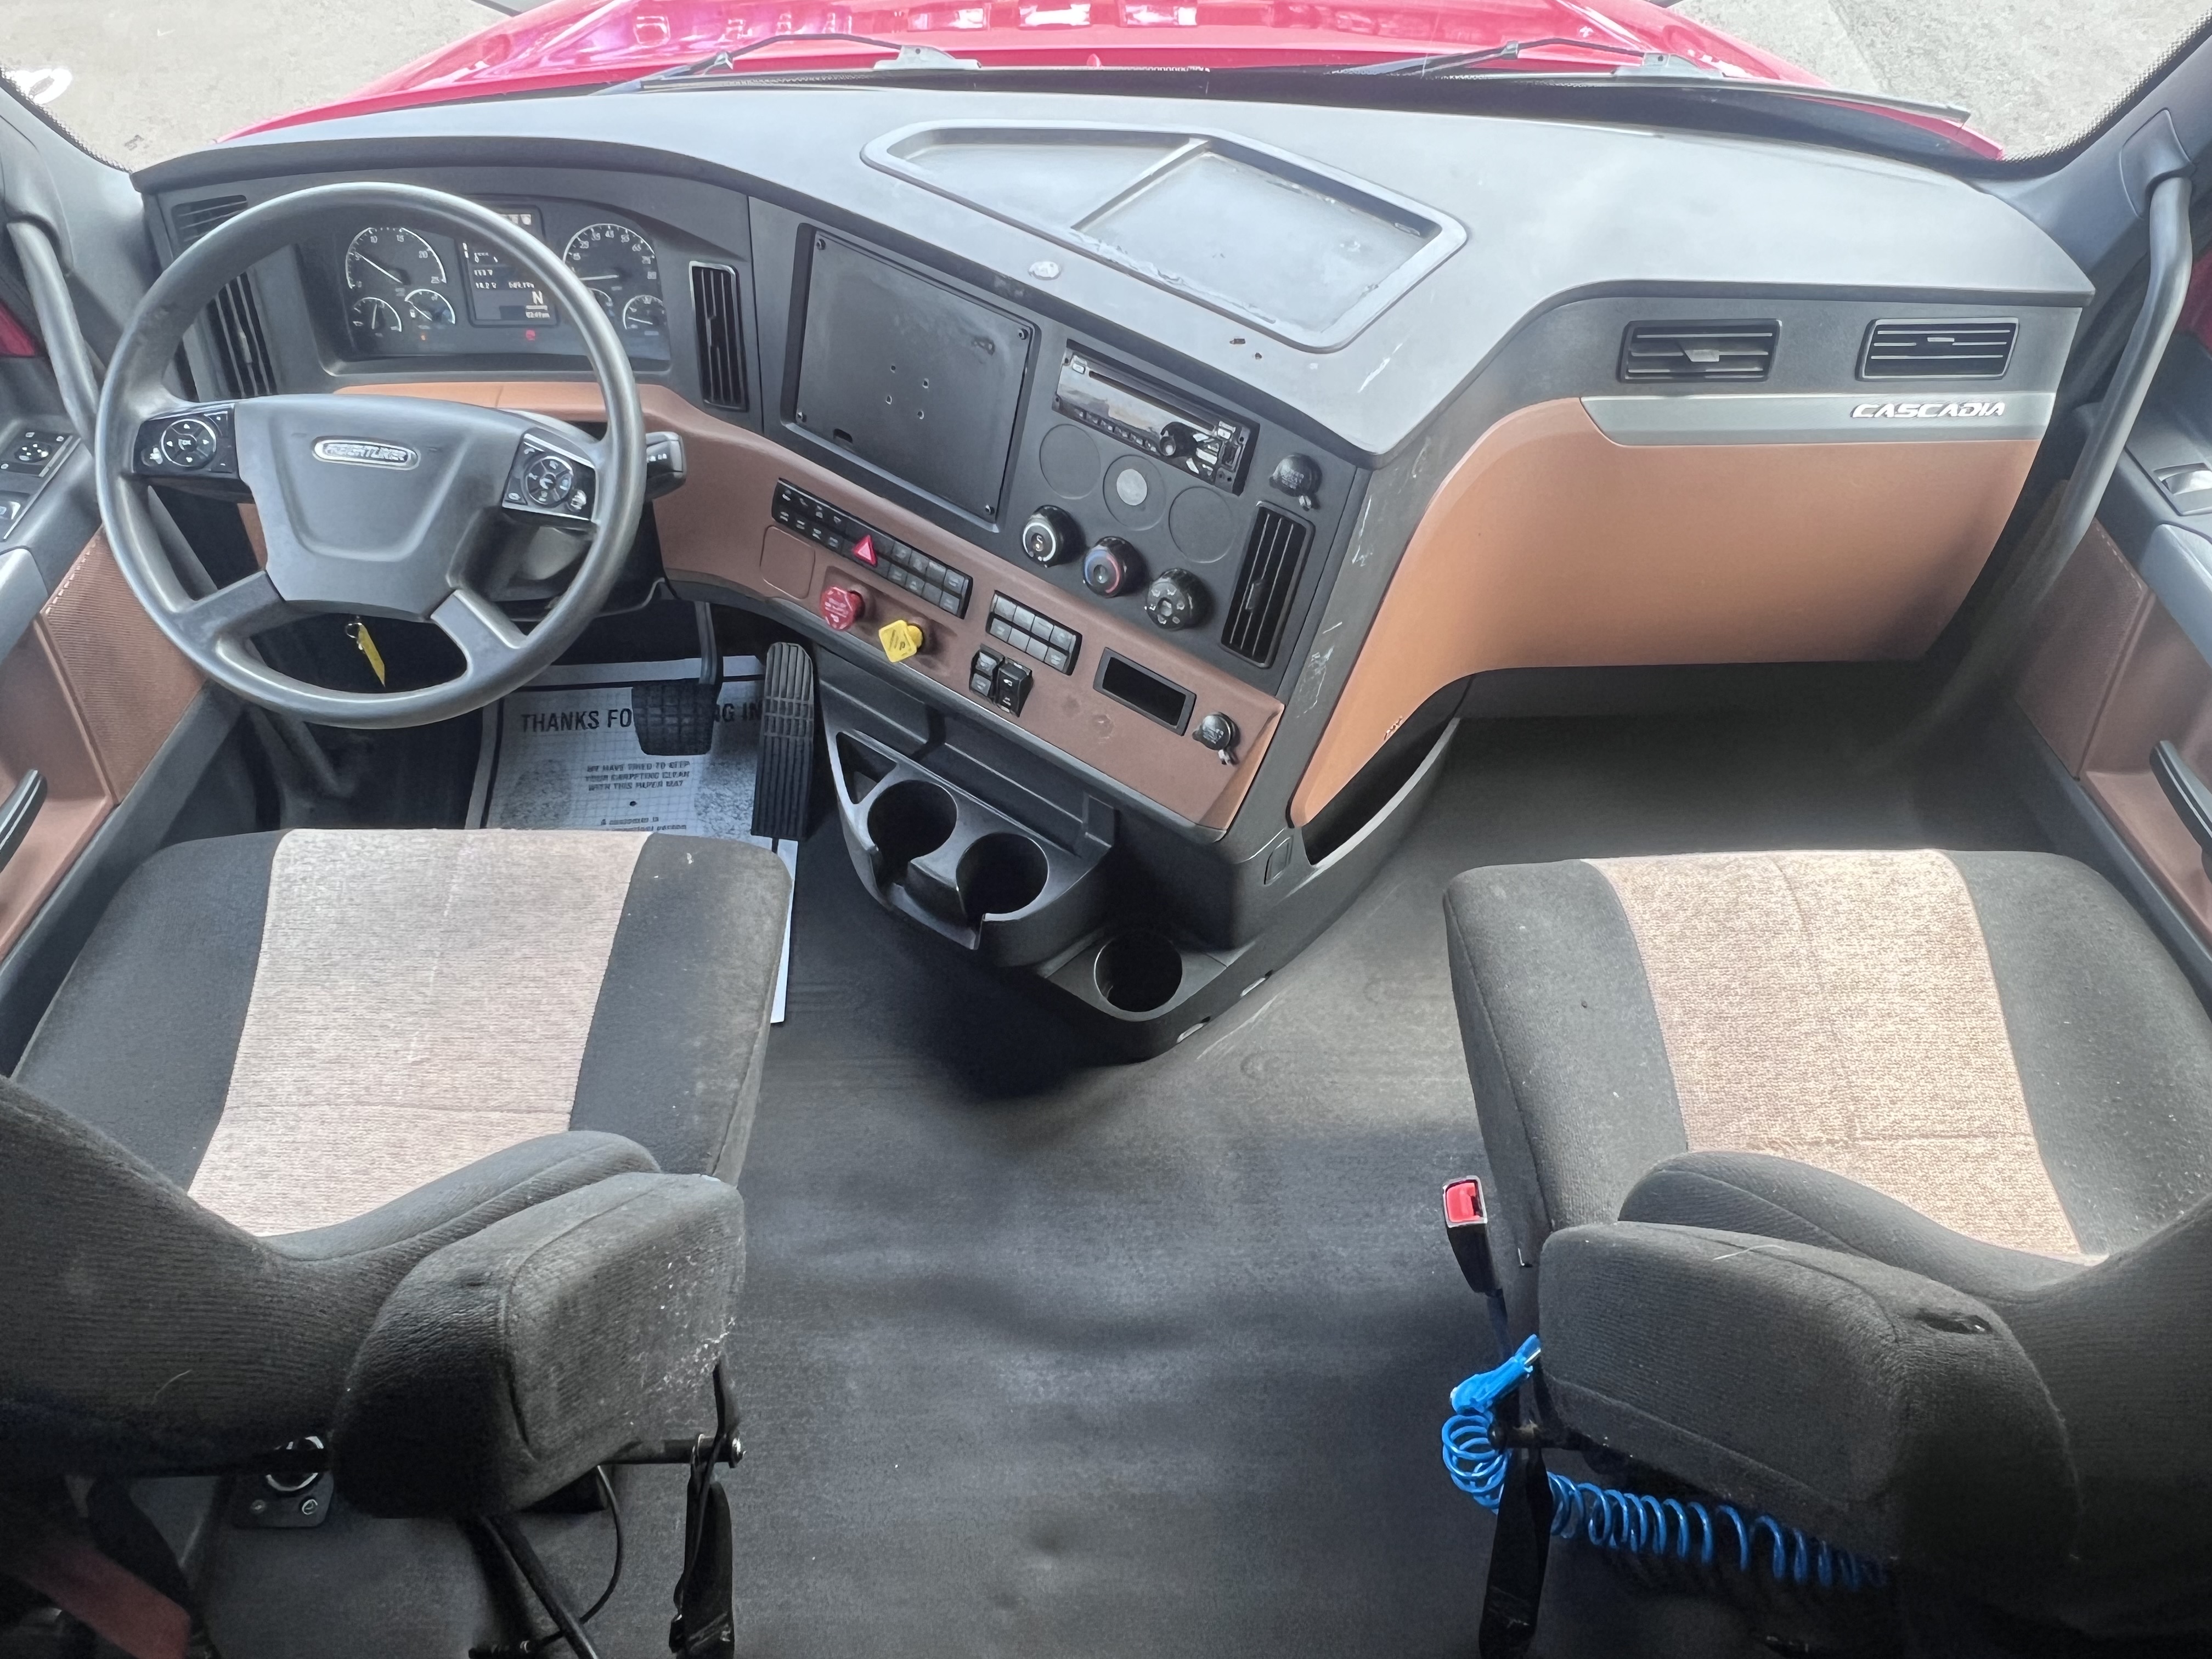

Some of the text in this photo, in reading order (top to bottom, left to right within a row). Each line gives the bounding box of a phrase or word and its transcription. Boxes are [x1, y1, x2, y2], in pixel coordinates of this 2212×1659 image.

[532, 290, 544, 304] N
[1850, 402, 2005, 418] CASCADIA
[522, 710, 600, 732] THANKS
[607, 708, 633, 728] FO
